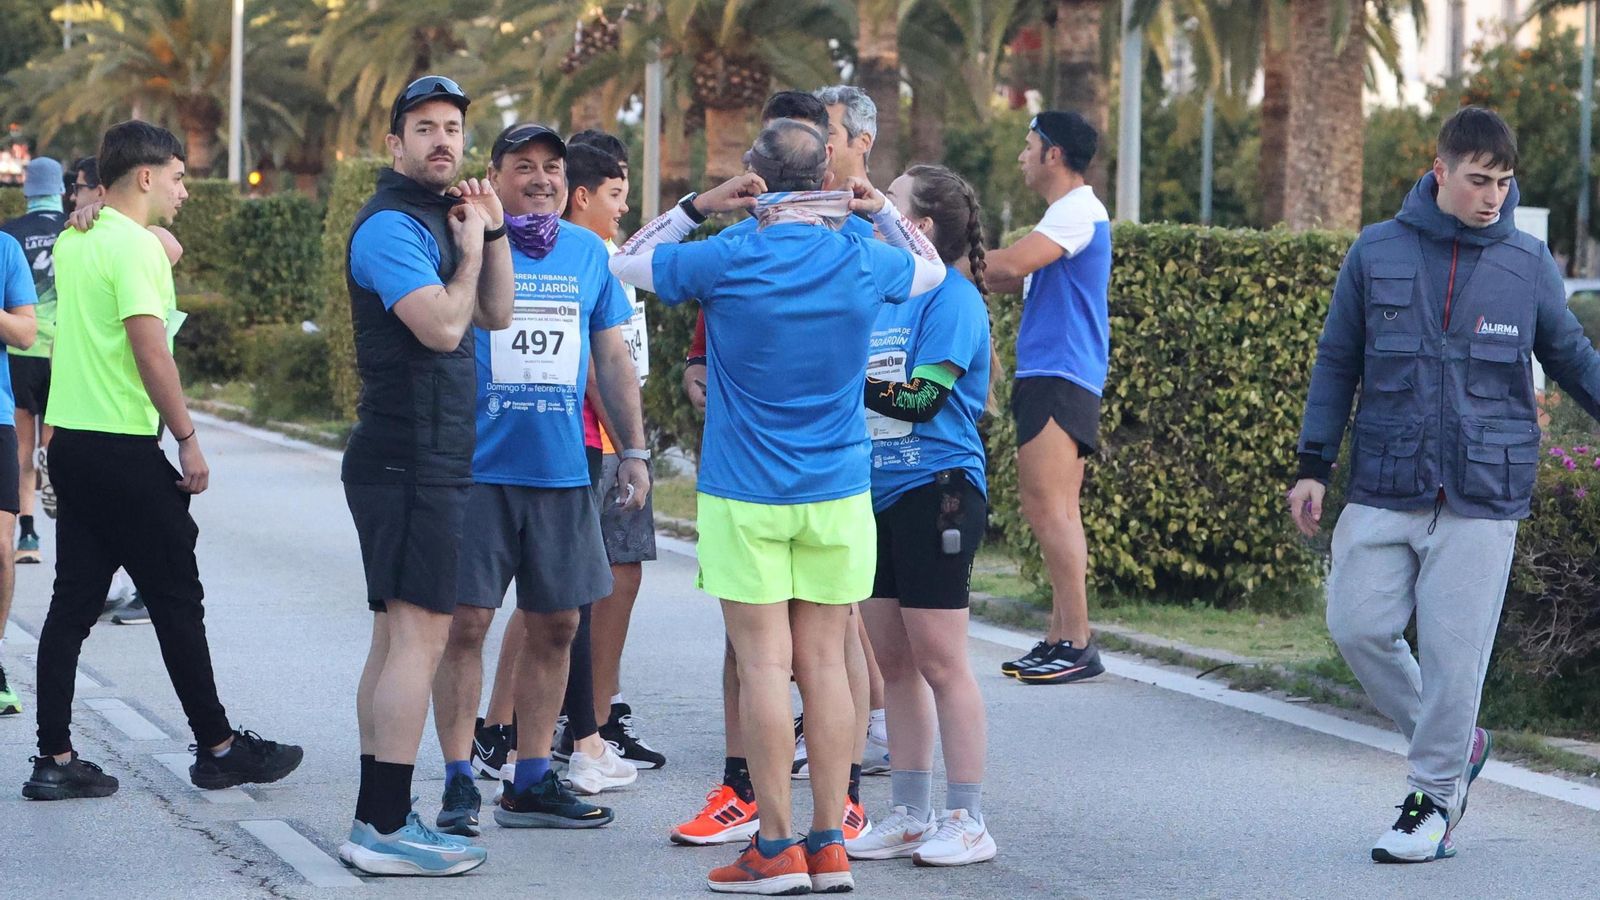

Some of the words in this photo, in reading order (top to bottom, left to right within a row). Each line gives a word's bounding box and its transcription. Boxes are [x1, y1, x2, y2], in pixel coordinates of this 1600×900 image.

[568, 275, 578, 283] DE
[514, 281, 537, 292] DAD
[538, 281, 580, 294] JARDÍN
[1480, 321, 1519, 335] ALIRMA
[511, 329, 565, 356] 497
[486, 382, 520, 394] Domingo
[520, 383, 527, 392] 9
[534, 385, 562, 393] febrero
[567, 385, 577, 394] 202
[900, 435, 920, 445] 2025
